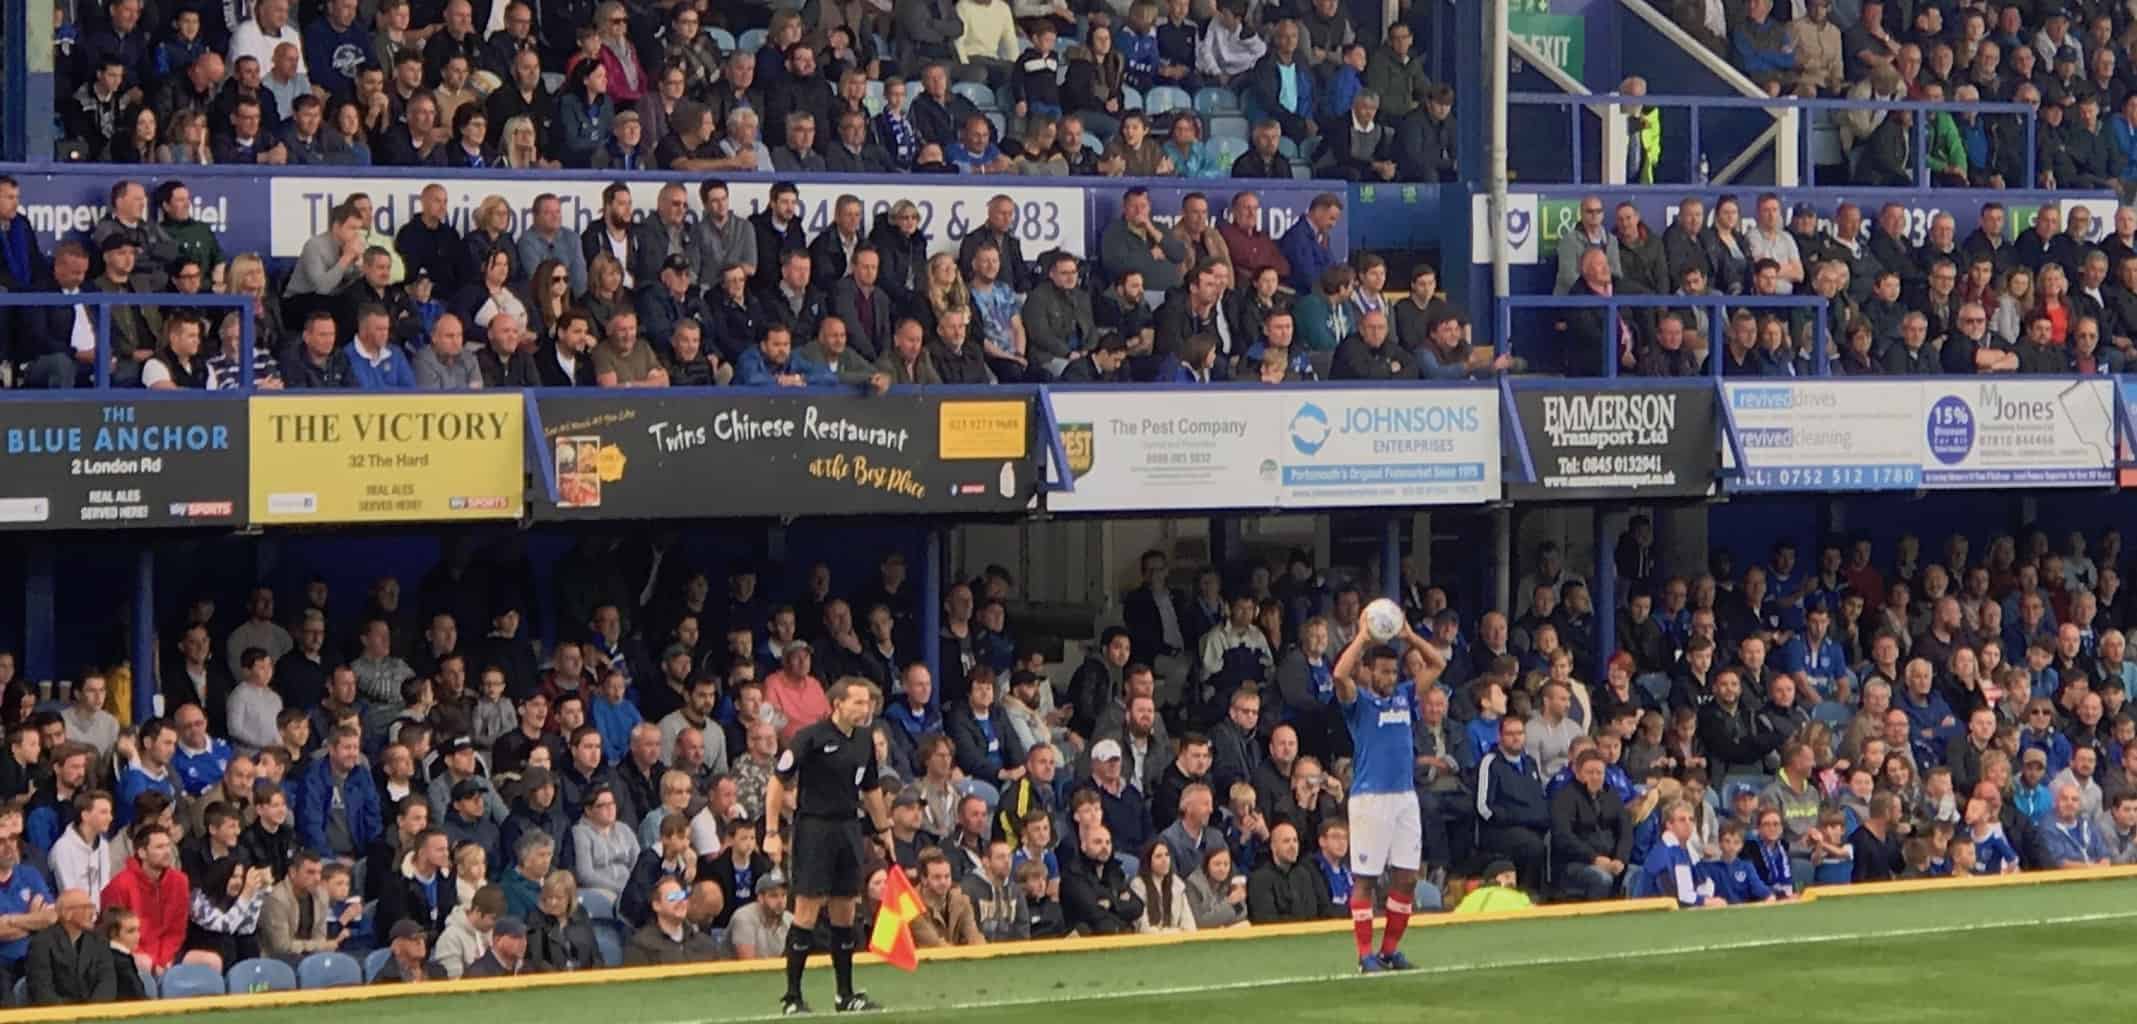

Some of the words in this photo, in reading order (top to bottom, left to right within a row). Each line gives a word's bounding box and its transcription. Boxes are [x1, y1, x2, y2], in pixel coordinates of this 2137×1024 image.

[947, 201, 969, 241] &
[1008, 201, 1061, 241] 983
[103, 407, 135, 422] THE
[1341, 405, 1479, 433] JOHNSONS
[1543, 394, 1676, 432] EMMERSON
[1934, 406, 1968, 424] 15%
[1993, 396, 2055, 421] Jones
[269, 413, 341, 443] THE
[352, 411, 509, 442] VICTORY
[648, 421, 706, 453] Twins
[714, 409, 795, 443] Chinese
[803, 405, 909, 452] Restaurant
[1109, 418, 1137, 435] The
[1142, 418, 1174, 435] Pest
[1178, 417, 1247, 437] Company
[1550, 428, 1634, 450] Transport
[1638, 426, 1668, 444] Ltd
[1740, 428, 1792, 447] revived
[8, 428, 81, 453] BLUE
[94, 425, 229, 451] ANCHOR
[1061, 432, 1091, 455] EST
[1373, 440, 1455, 453] ENTERPRISES
[71, 459, 81, 475] 2
[84, 457, 137, 474] London
[140, 457, 162, 473] Rd
[349, 454, 365, 468] 32
[368, 453, 393, 467] The
[396, 453, 430, 467] Hard
[809, 457, 824, 478] at
[825, 453, 849, 481] the
[852, 454, 886, 489] Best
[1558, 457, 1580, 474] Tel:
[1737, 471, 1771, 485] EL:
[1779, 469, 1823, 485] 0752
[1832, 468, 1862, 484] 512
[1873, 468, 1914, 484] 1780
